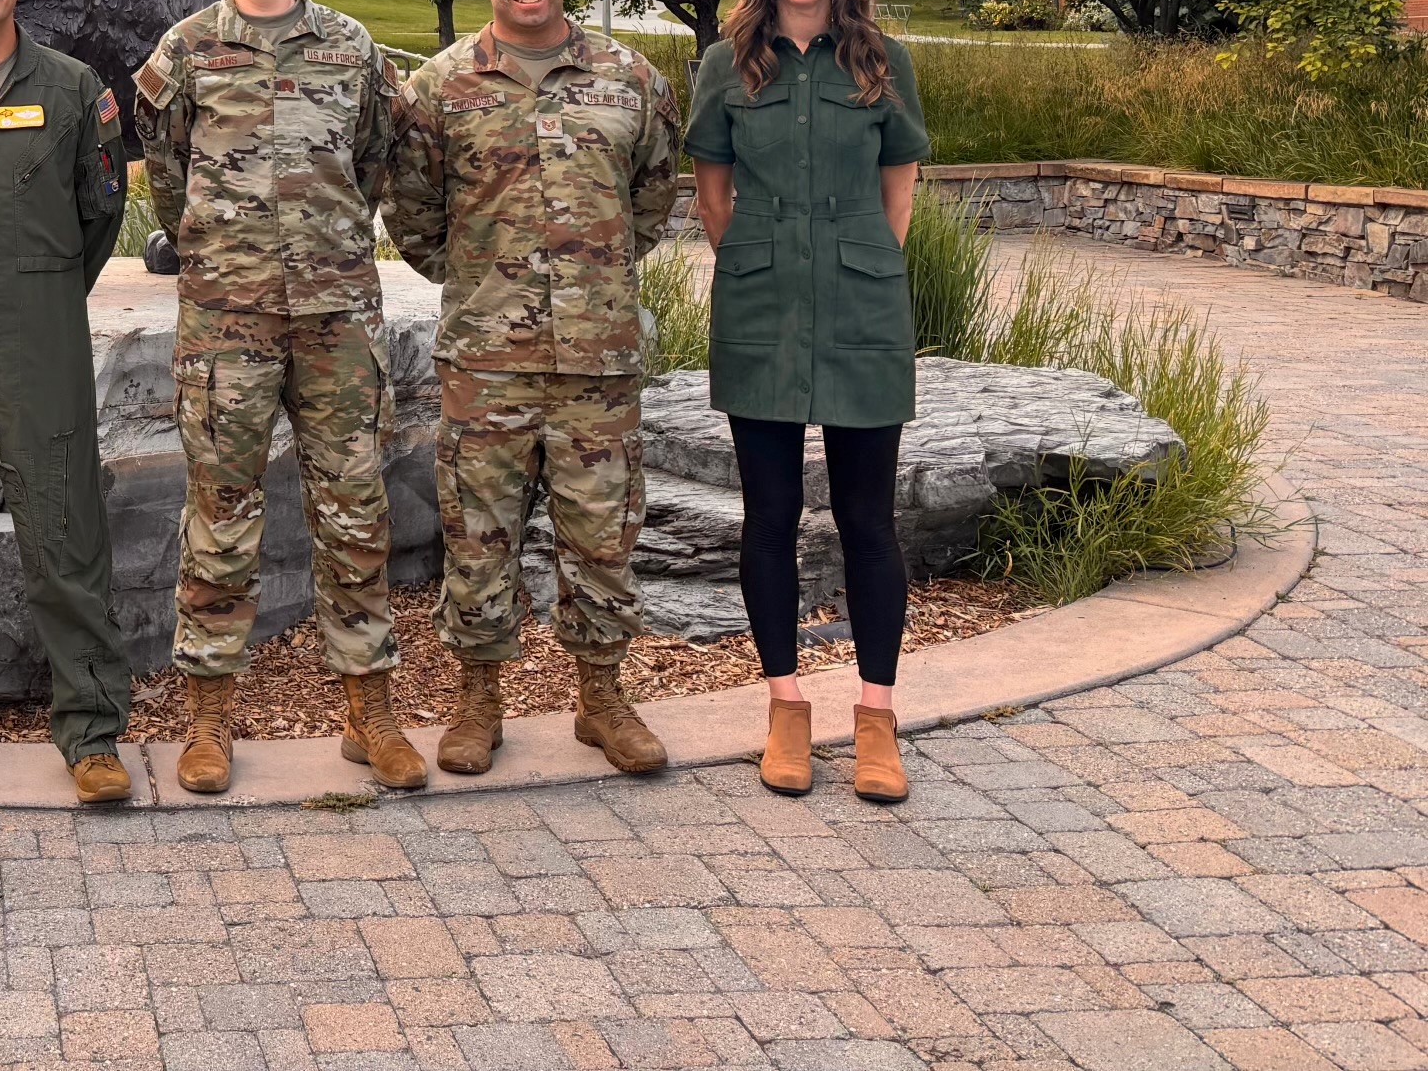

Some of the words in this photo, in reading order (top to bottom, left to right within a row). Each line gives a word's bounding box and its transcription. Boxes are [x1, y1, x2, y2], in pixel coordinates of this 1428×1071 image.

[207, 55, 238, 68] MEANS
[322, 51, 334, 62] AIR
[335, 52, 360, 66] FORCE
[452, 94, 499, 110] AMUNDSEN
[602, 94, 616, 104] AIR
[616, 95, 639, 108] FORCE
